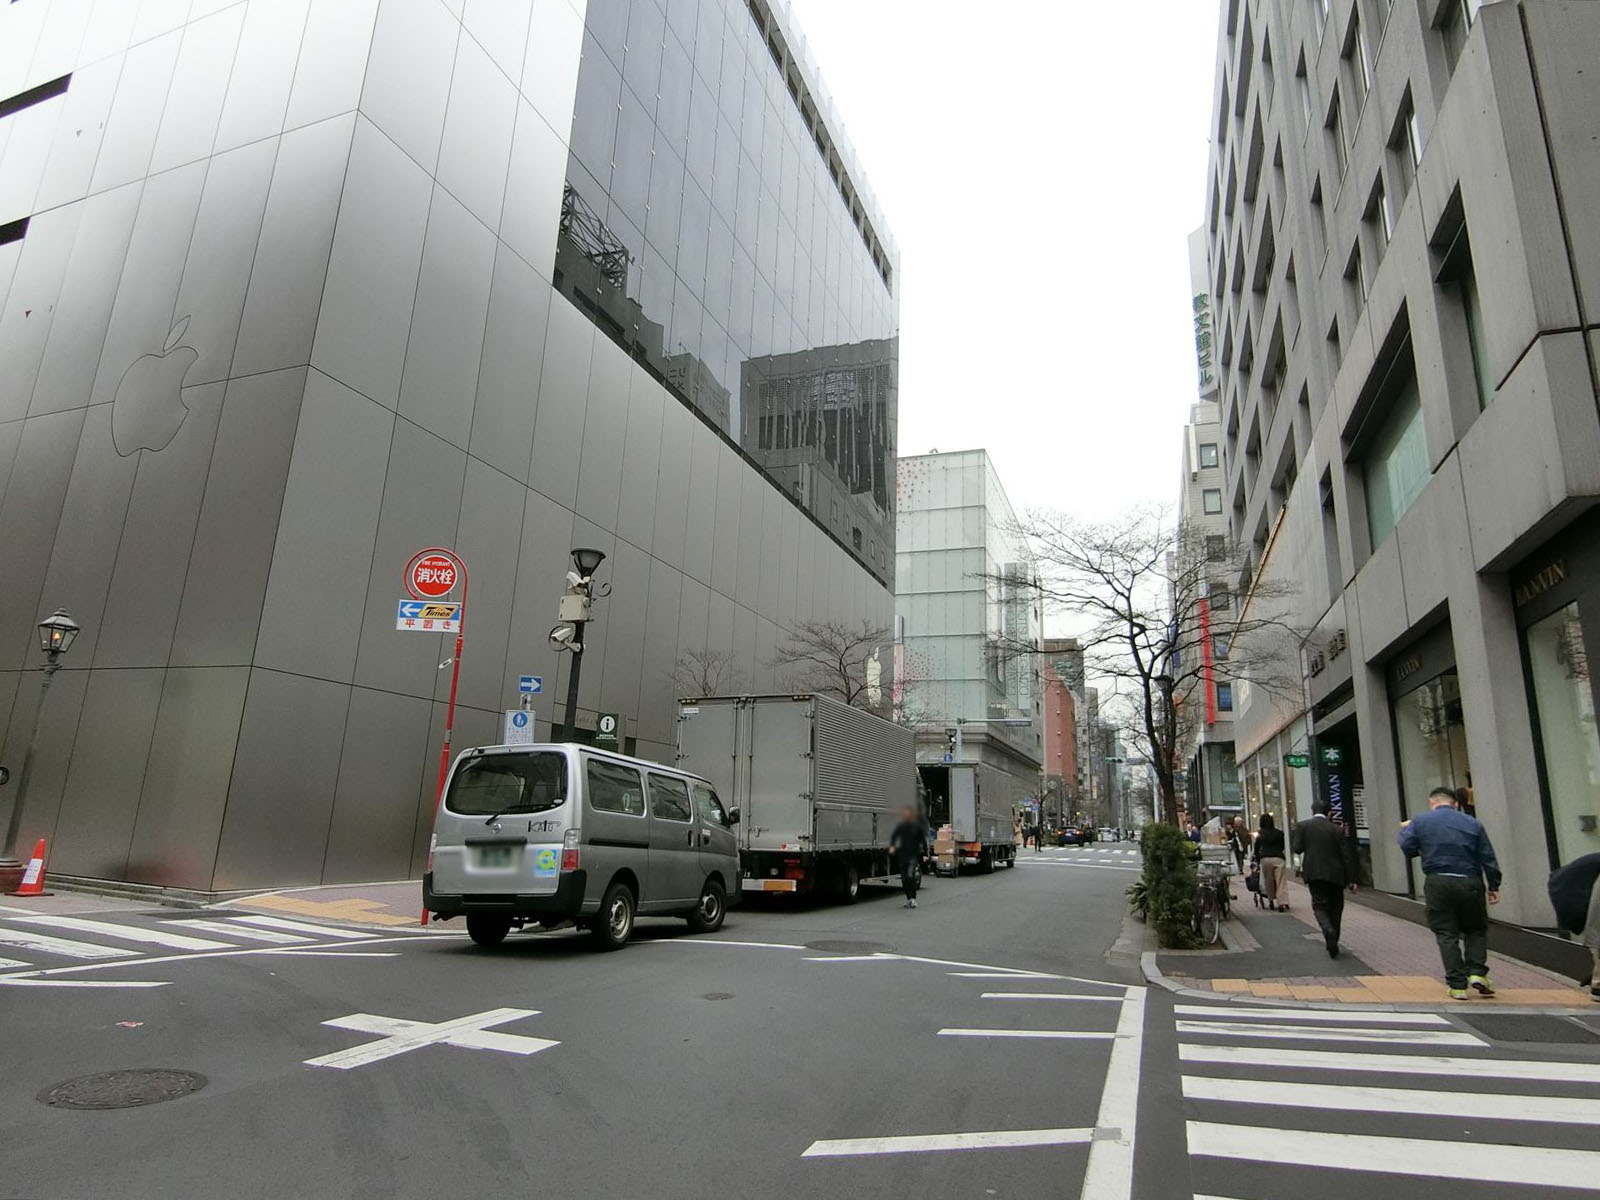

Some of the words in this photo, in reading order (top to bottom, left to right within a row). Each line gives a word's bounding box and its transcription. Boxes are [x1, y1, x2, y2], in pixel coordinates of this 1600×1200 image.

[416, 567, 454, 585] 消火栓
[425, 607, 456, 617] Times
